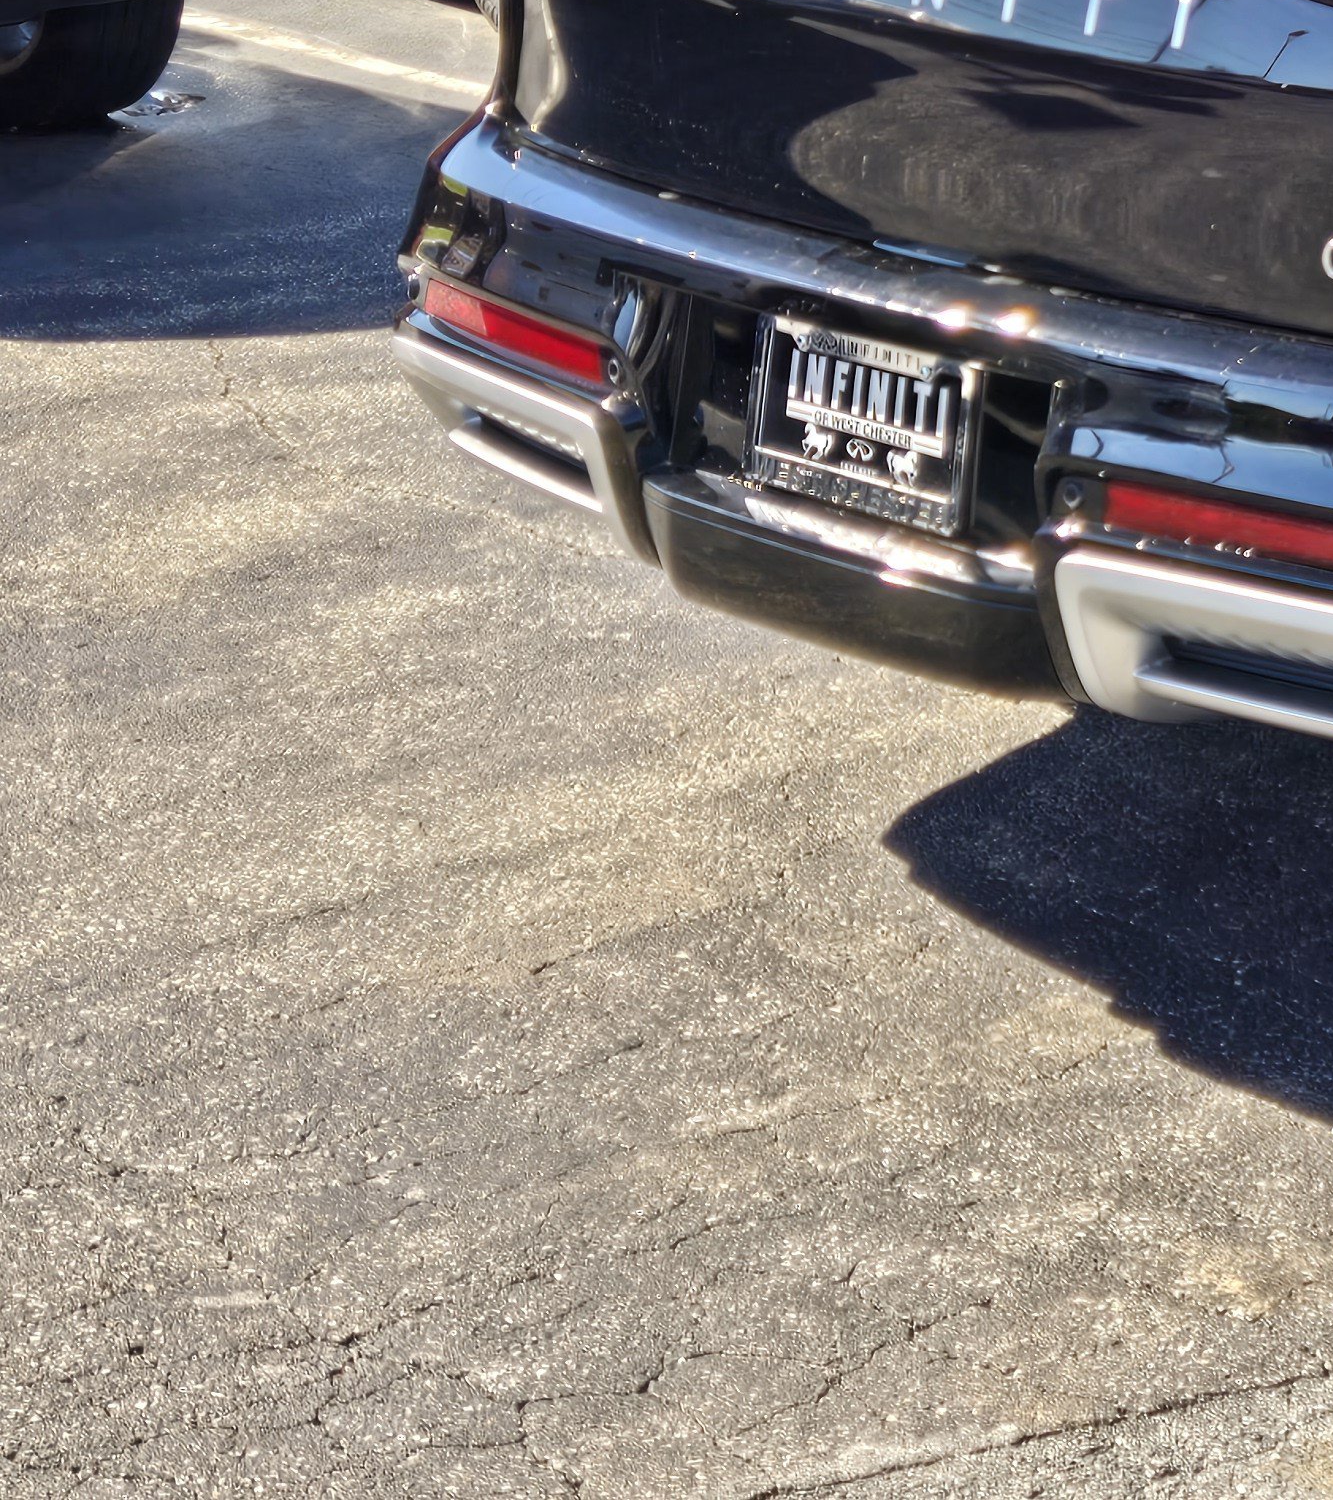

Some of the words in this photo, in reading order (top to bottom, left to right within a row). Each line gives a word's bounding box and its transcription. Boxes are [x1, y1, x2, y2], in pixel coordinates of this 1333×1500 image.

[788, 349, 949, 437] INFINITI
[832, 415, 860, 434] WEST
[863, 423, 912, 448] CHESTER
